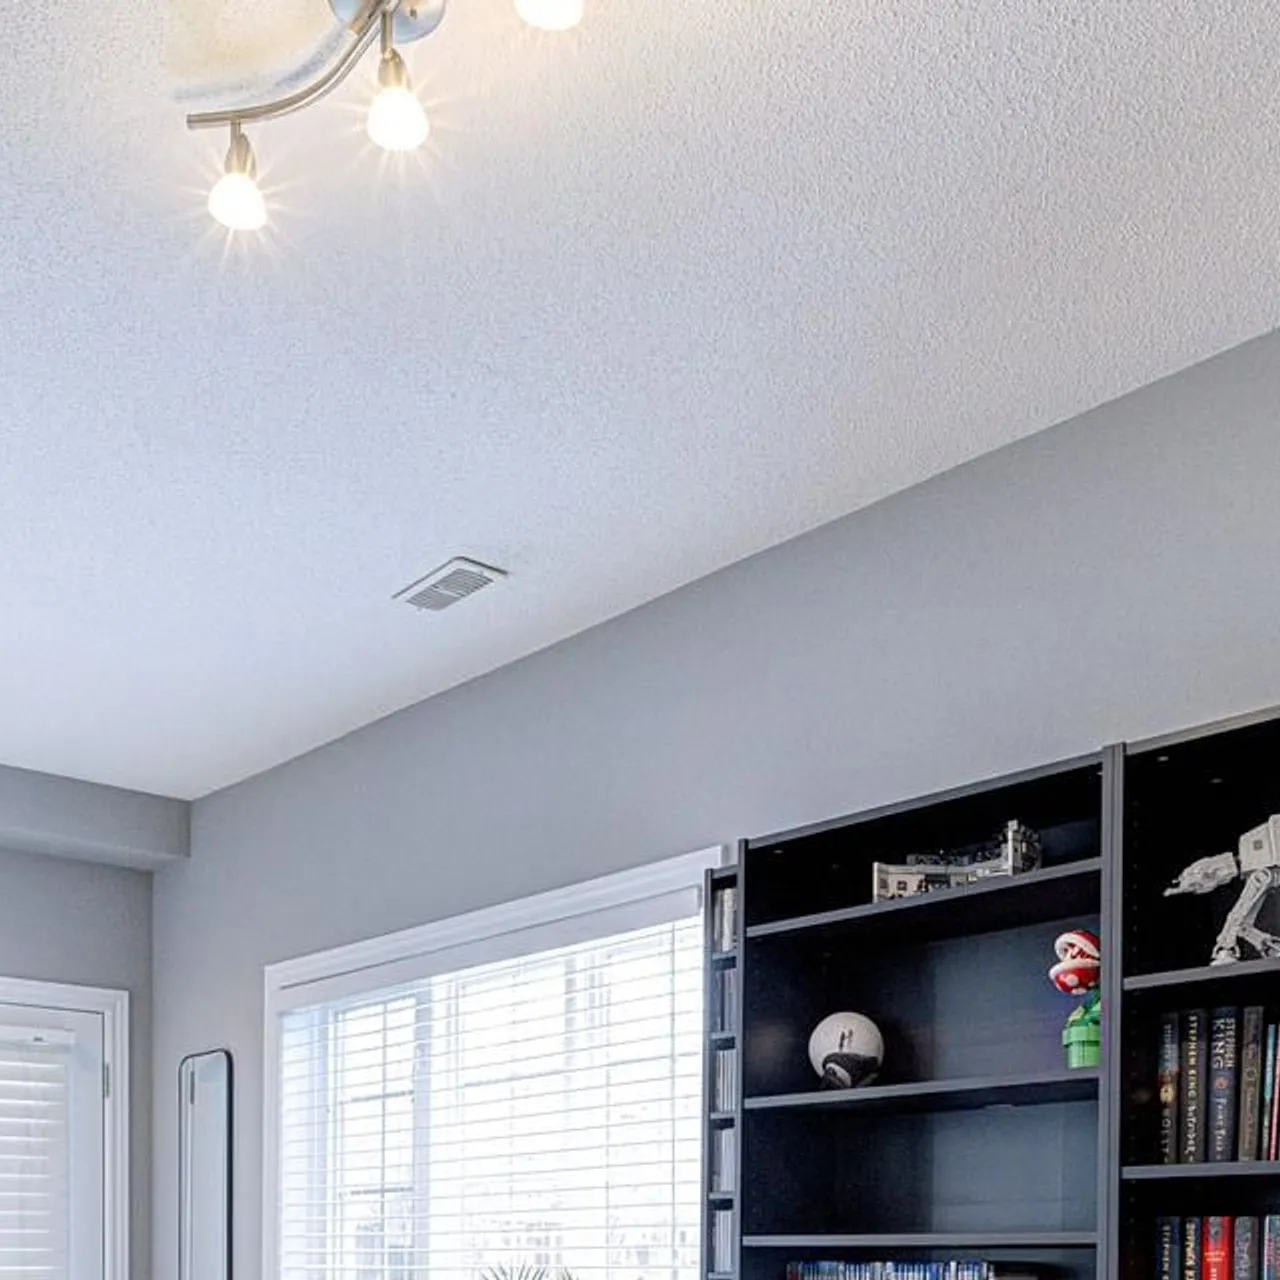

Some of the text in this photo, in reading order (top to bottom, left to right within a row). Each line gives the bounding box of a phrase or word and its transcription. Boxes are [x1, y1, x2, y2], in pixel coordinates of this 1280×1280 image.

[1188, 1014, 1198, 1065] STEPHEN
[1212, 1017, 1225, 1070] KING
[1225, 1017, 1236, 1068] STEPHEN
[1187, 1069, 1198, 1098] KING
[1162, 1225, 1171, 1271] STEPHEN
